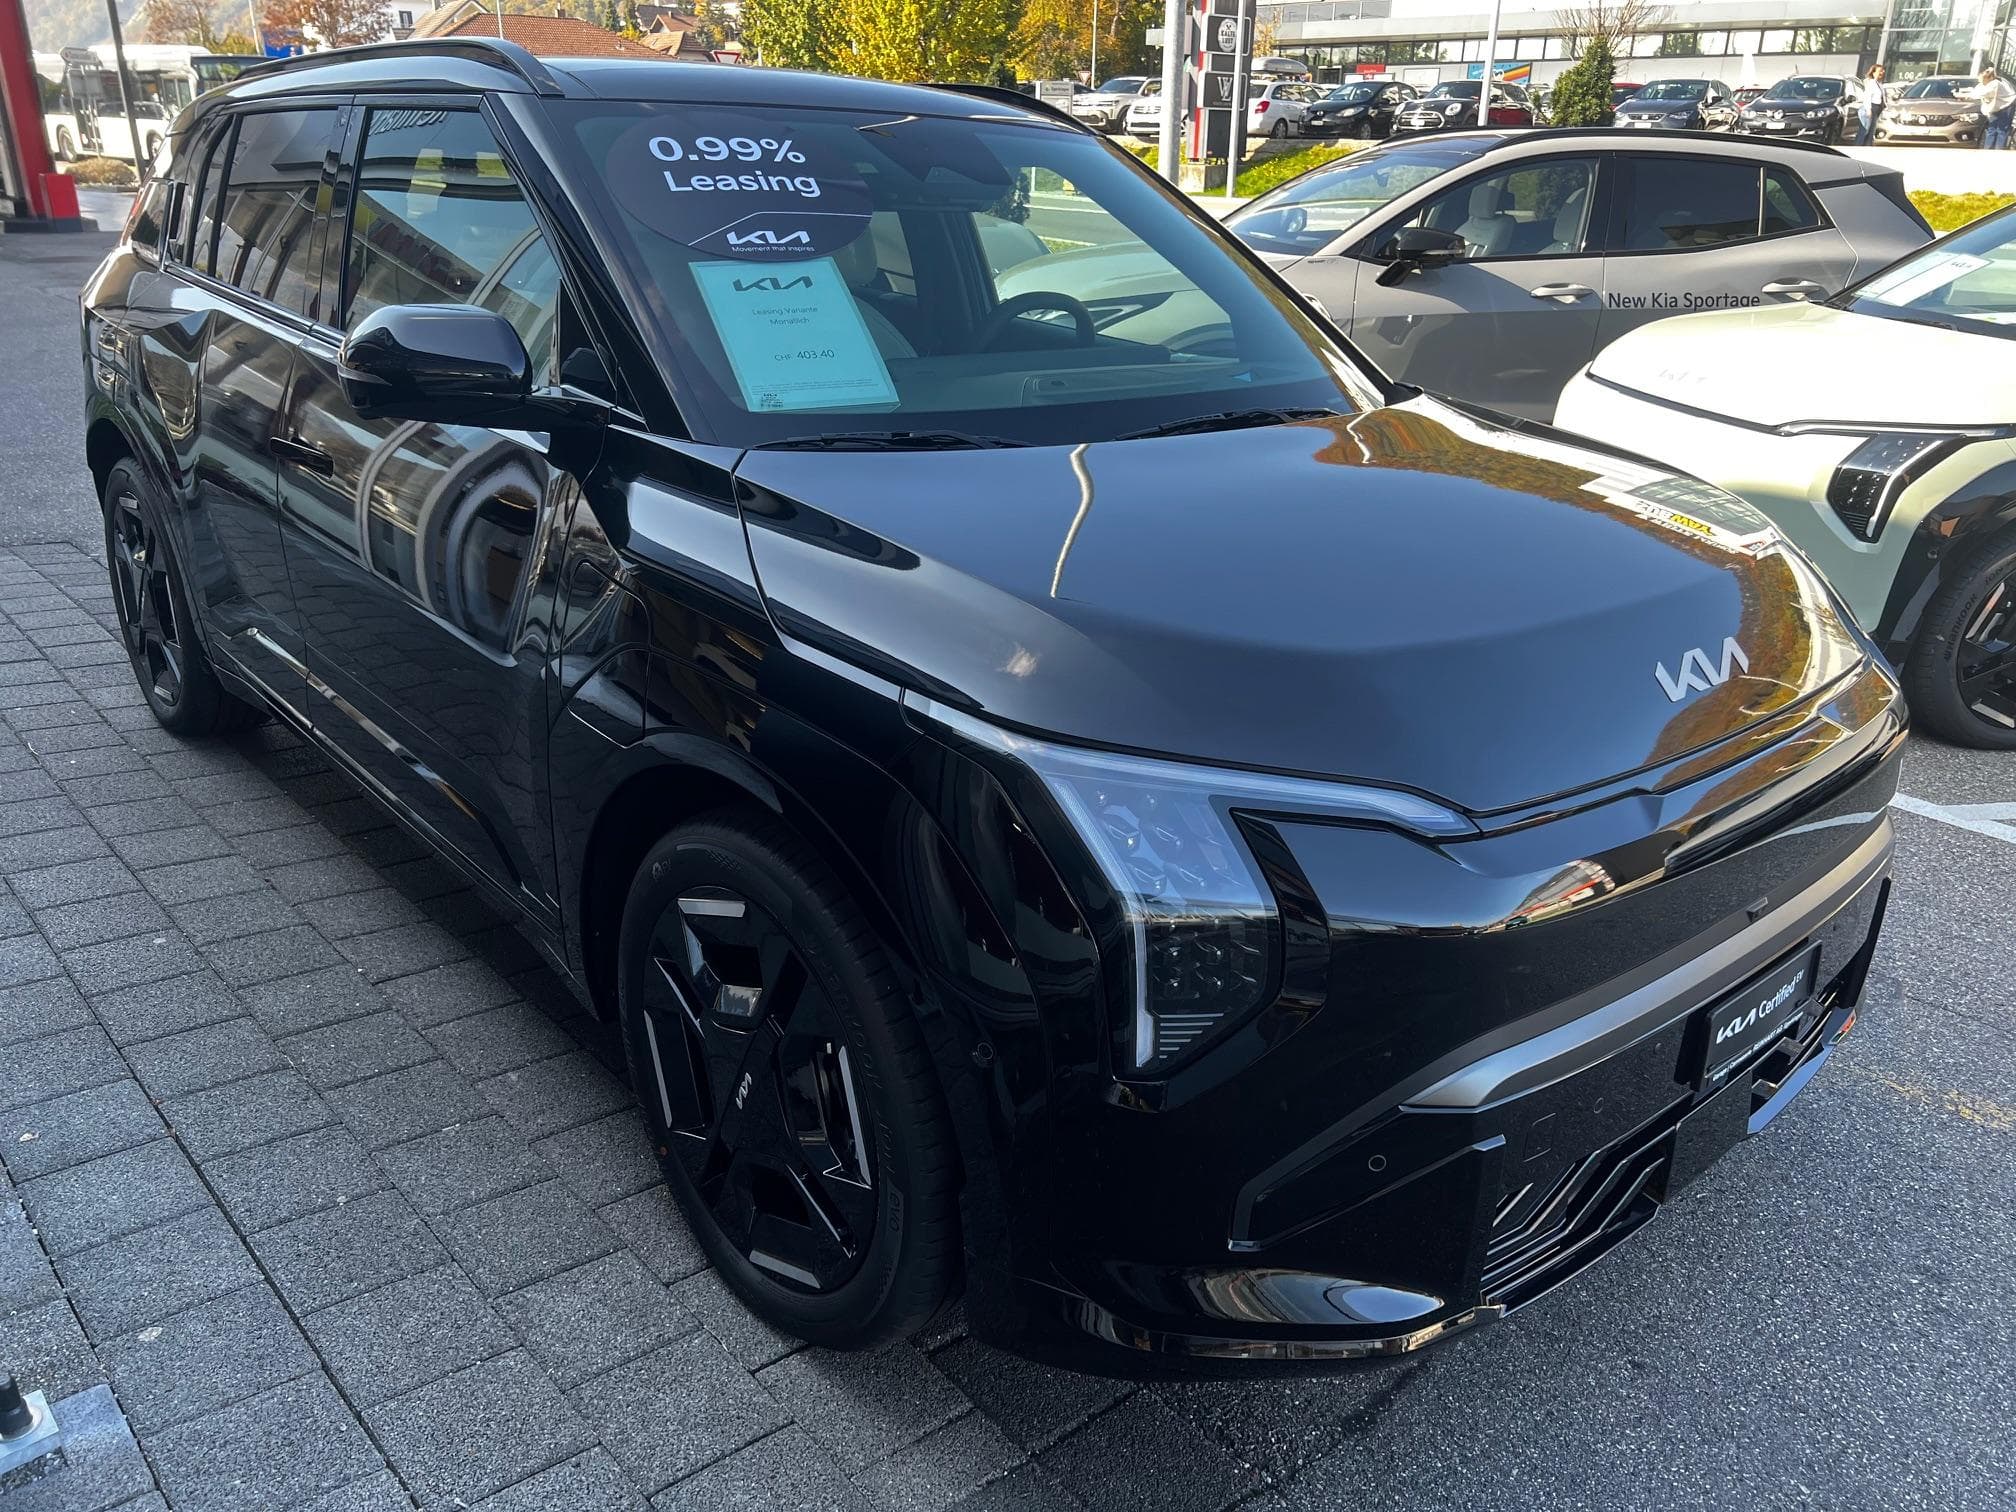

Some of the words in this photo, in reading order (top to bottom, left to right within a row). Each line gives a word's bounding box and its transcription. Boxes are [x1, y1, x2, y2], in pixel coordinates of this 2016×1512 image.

[648, 136, 806, 163] 0.99%
[663, 170, 822, 198] Leasing
[726, 230, 811, 245] KIA
[733, 275, 813, 292] KIA
[752, 308, 783, 316] Leasing
[1608, 292, 1646, 308] New
[1651, 292, 1678, 308] Kia
[1683, 292, 1760, 312] Sportage
[774, 353, 792, 361] CHF
[1654, 636, 1749, 702] KIA
[1715, 1008, 1757, 1045] KIA
[1758, 976, 1797, 1018] Certified
